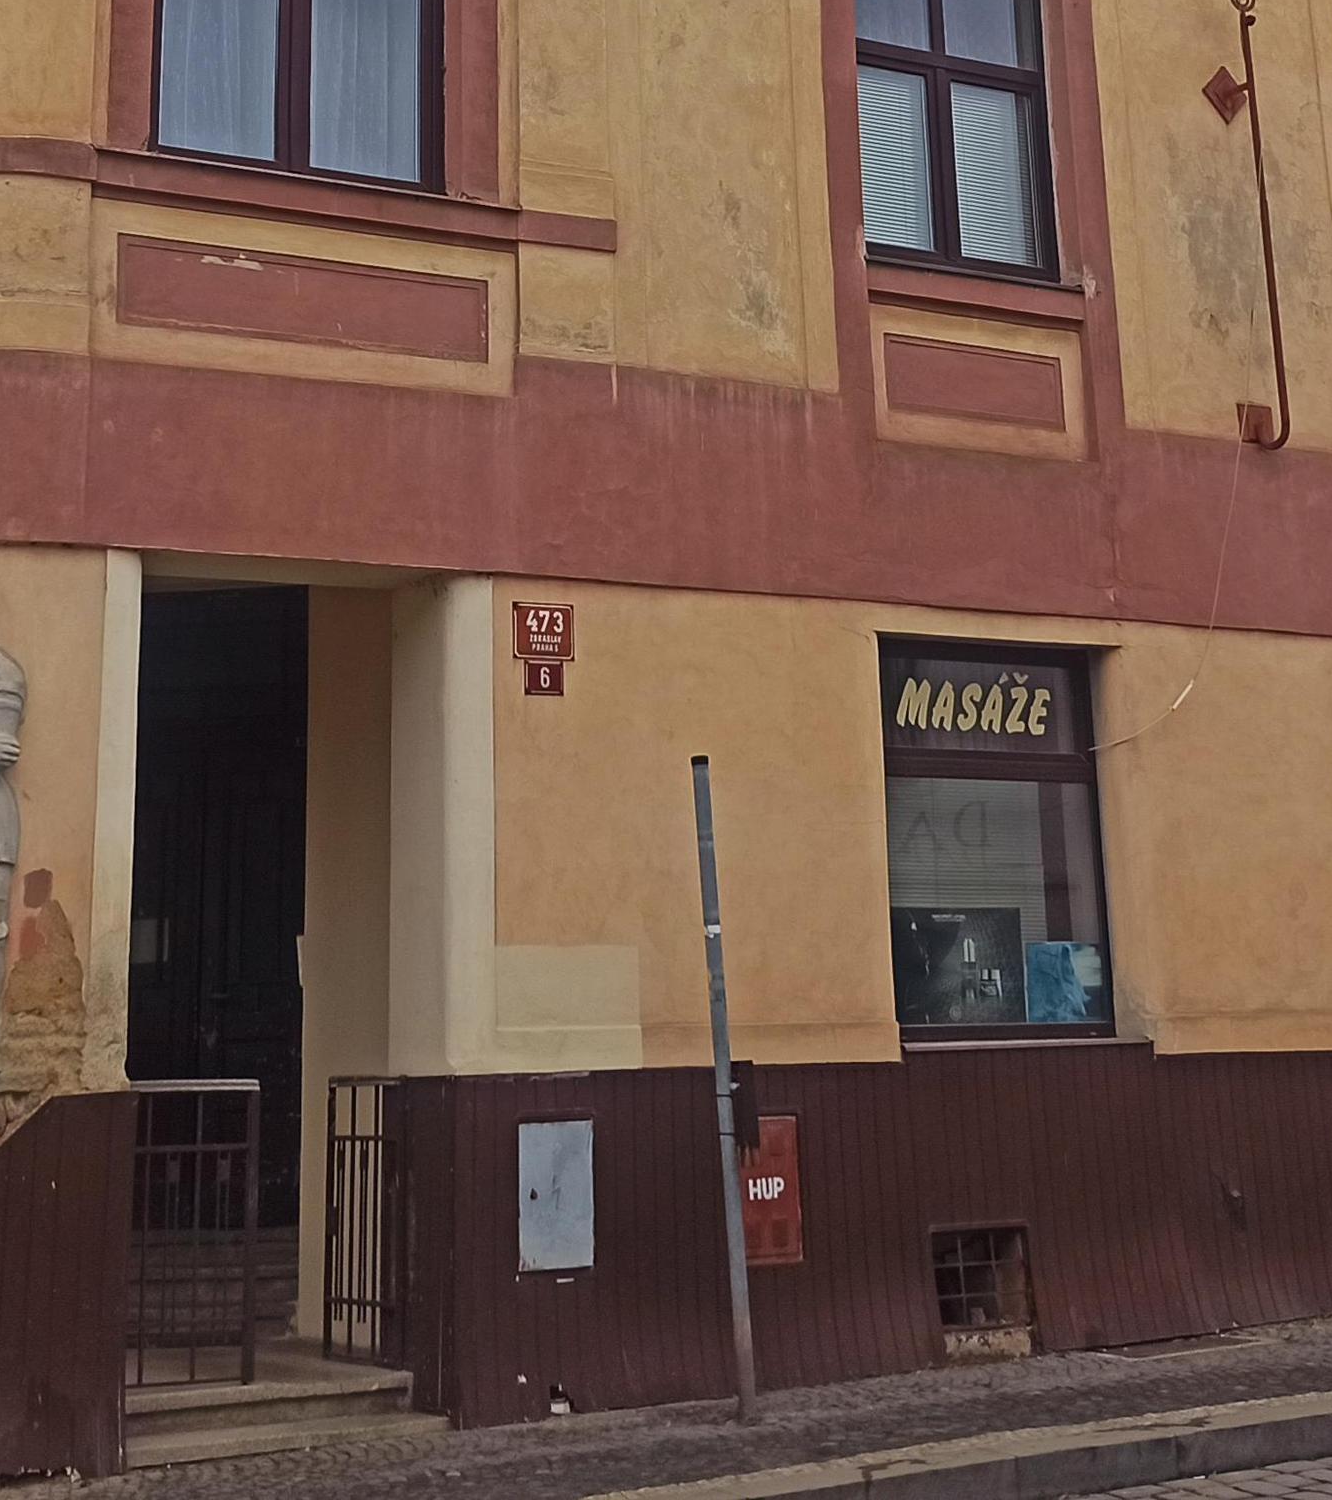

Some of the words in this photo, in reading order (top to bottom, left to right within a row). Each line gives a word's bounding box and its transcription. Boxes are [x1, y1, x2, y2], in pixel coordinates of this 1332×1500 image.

[526, 609, 564, 633] 473
[529, 633, 562, 644] ZBRASLAV
[531, 643, 553, 652] PRAHA
[554, 644, 559, 653] 5
[540, 666, 550, 688] 6
[896, 671, 1051, 736] MASÁŽE
[748, 1177, 785, 1201] HUP
